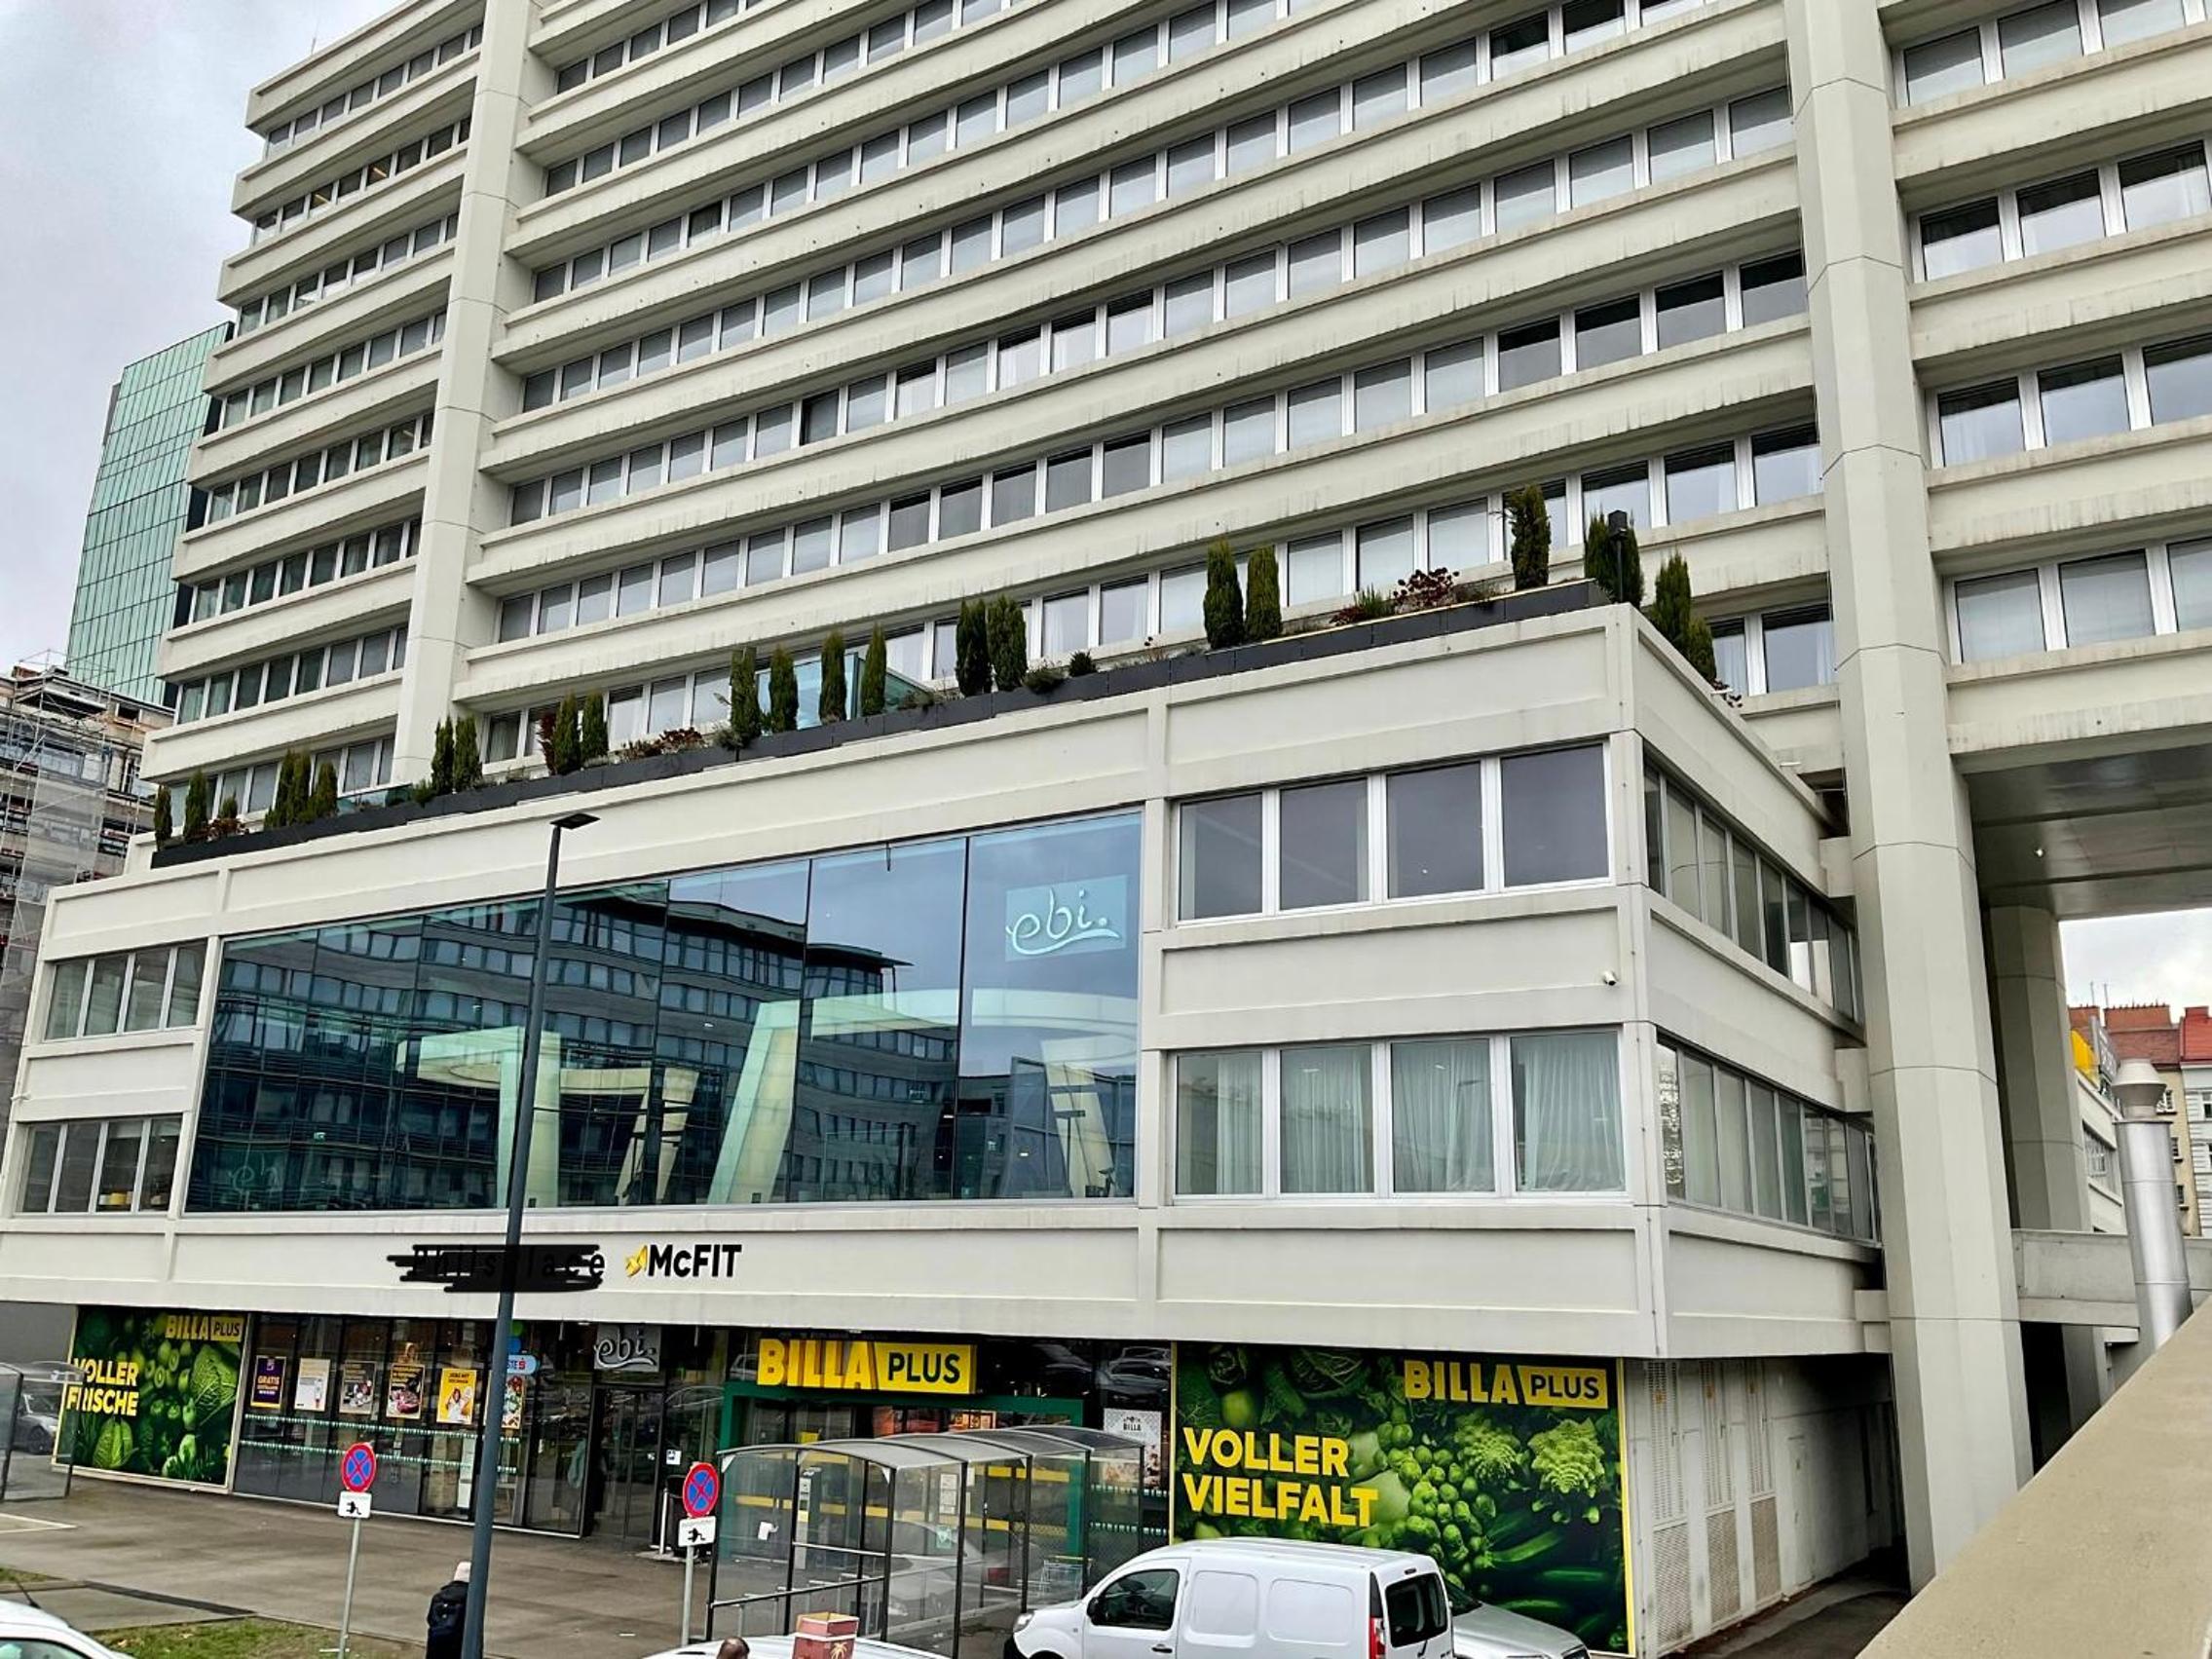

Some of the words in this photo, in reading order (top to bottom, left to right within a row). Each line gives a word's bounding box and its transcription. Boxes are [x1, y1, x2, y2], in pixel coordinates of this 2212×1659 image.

[648, 1244, 742, 1278] McFIT
[164, 1315, 209, 1340] BILLA
[213, 1321, 241, 1338] PLUS
[757, 1338, 874, 1390] BILLA
[887, 1351, 961, 1384] PLUS
[1403, 1359, 1518, 1405] BILLA
[1530, 1373, 1600, 1401] PLUS
[1182, 1427, 1350, 1478] VOLLER
[1182, 1473, 1379, 1527] VIELFALT
